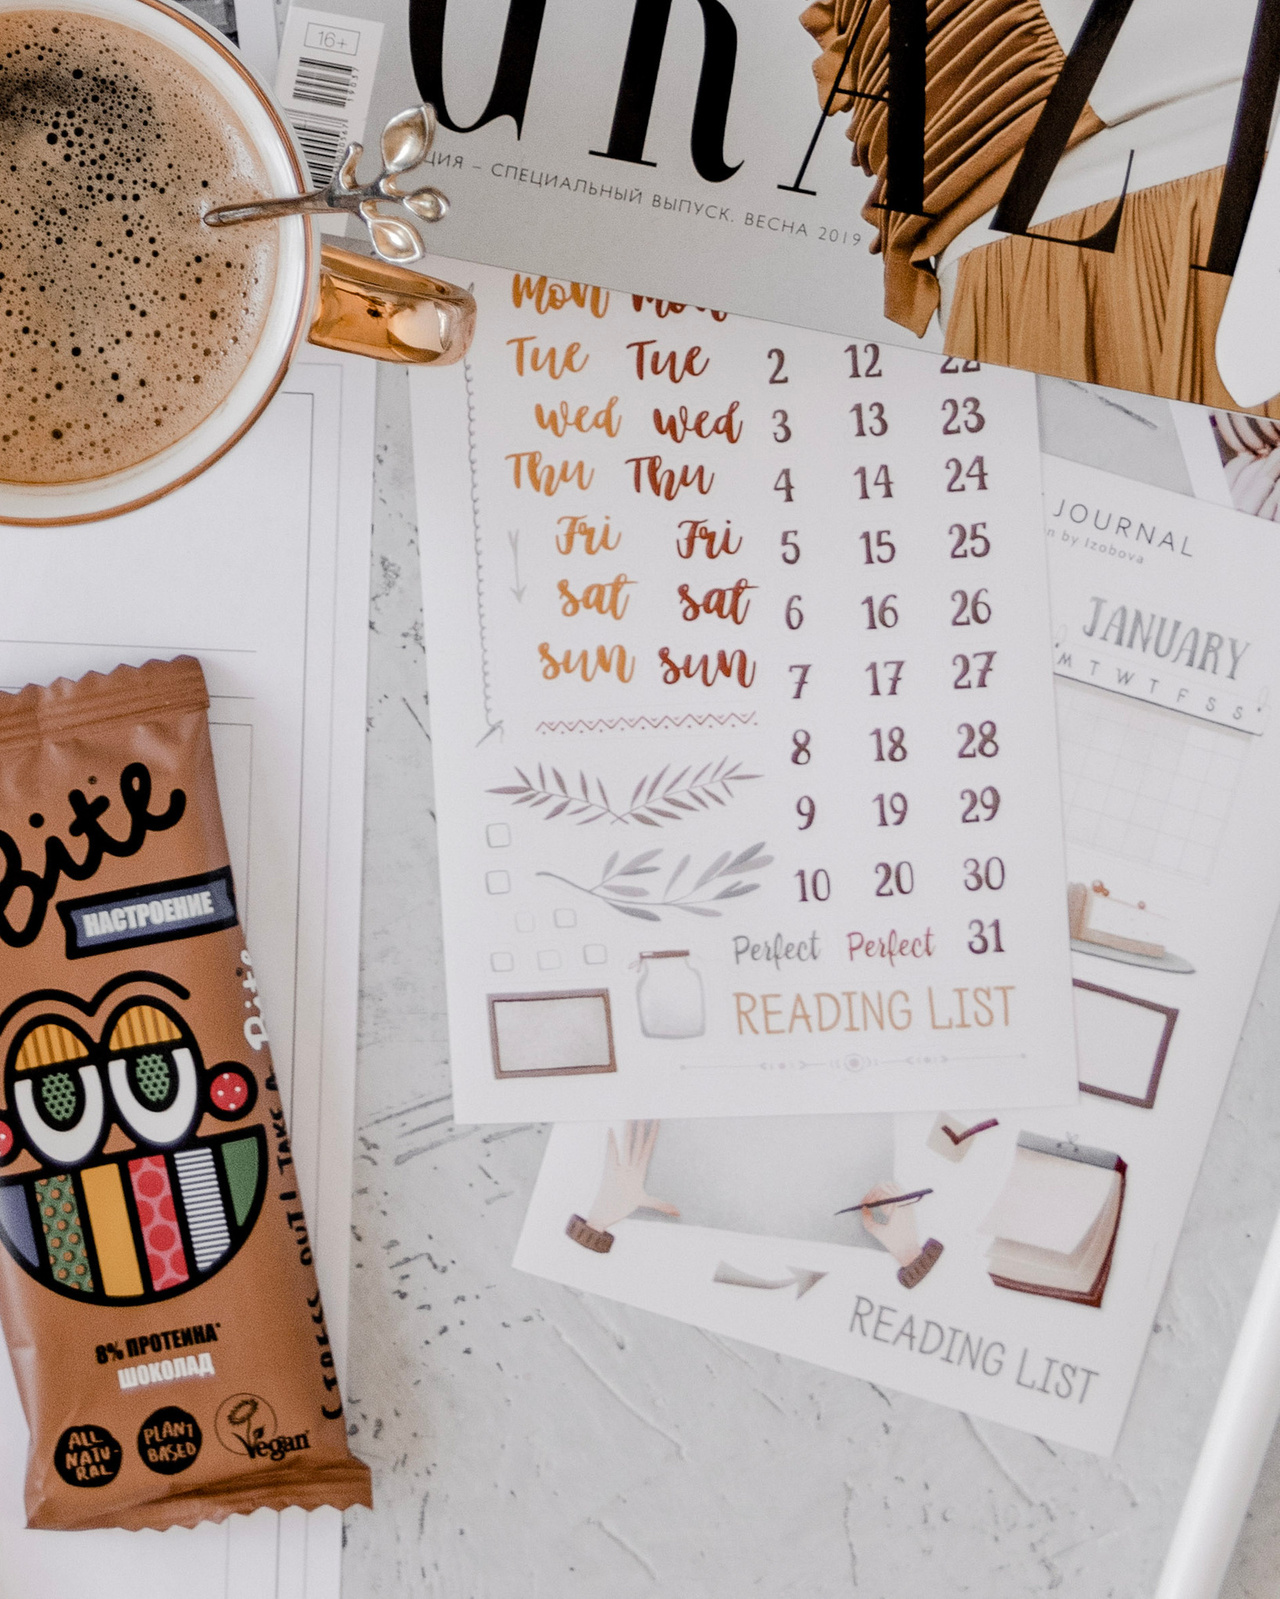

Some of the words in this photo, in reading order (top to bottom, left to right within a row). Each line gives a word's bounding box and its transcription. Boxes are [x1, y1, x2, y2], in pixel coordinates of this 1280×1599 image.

[318, 30, 348, 50] 16+
[424, 151, 464, 169] ЦИЯ
[491, 163, 643, 204] СПЕЦИАЛЬНЫЙ
[744, 212, 808, 237] ВЕСНА
[818, 226, 862, 246] 2019
[506, 336, 589, 379] Tue
[626, 340, 710, 384] Tue
[766, 347, 789, 384] 2
[843, 343, 883, 379] 12
[772, 409, 792, 443] 3
[849, 402, 888, 438] 13
[941, 396, 986, 435] 23
[505, 451, 595, 497] Thu
[625, 455, 715, 501] Thu
[773, 467, 795, 502] 4
[853, 464, 895, 500] 14
[944, 455, 989, 493] 24
[555, 515, 621, 556] Fri
[676, 519, 743, 559] Fri
[781, 530, 801, 565] 5
[859, 530, 896, 565] 15
[948, 522, 991, 559] 25
[1052, 499, 1193, 558] JOURNAL
[1061, 528, 1079, 546] by
[784, 595, 804, 630] 6
[861, 594, 899, 630] 16
[950, 588, 992, 626] 26
[1082, 595, 1251, 680] JANUARY
[788, 663, 812, 699] 7
[865, 661, 906, 696] 17
[952, 651, 997, 690] 27
[1057, 651, 1072, 668] M
[1090, 660, 1100, 676] T
[1116, 668, 1135, 686] W
[1150, 678, 1160, 694] T
[1176, 688, 1189, 703] F
[1205, 697, 1216, 712] S
[1232, 705, 1243, 720] S
[790, 728, 812, 765] 8
[869, 726, 908, 762] 18
[956, 720, 1000, 760] 28
[795, 796, 816, 831] 9
[874, 791, 908, 827] 19
[960, 786, 1000, 824] 29
[794, 868, 831, 902] 10
[874, 861, 914, 896] 20
[962, 856, 1006, 893] 30
[82, 890, 214, 938] НАСТРОЕНИЕ
[732, 930, 821, 969] Perfect
[846, 927, 936, 967] Perfect
[967, 919, 1005, 954] 31
[732, 989, 913, 1035] READING
[928, 985, 1017, 1030] LIST
[117, 1352, 215, 1389] ШОКОЛАД
[848, 1296, 1006, 1378] READING
[1016, 1348, 1100, 1405] LIST
[68, 1431, 103, 1450] ALL
[143, 1421, 194, 1445] PLANT
[147, 1442, 197, 1463] BASED
[75, 1464, 114, 1481] RAL
